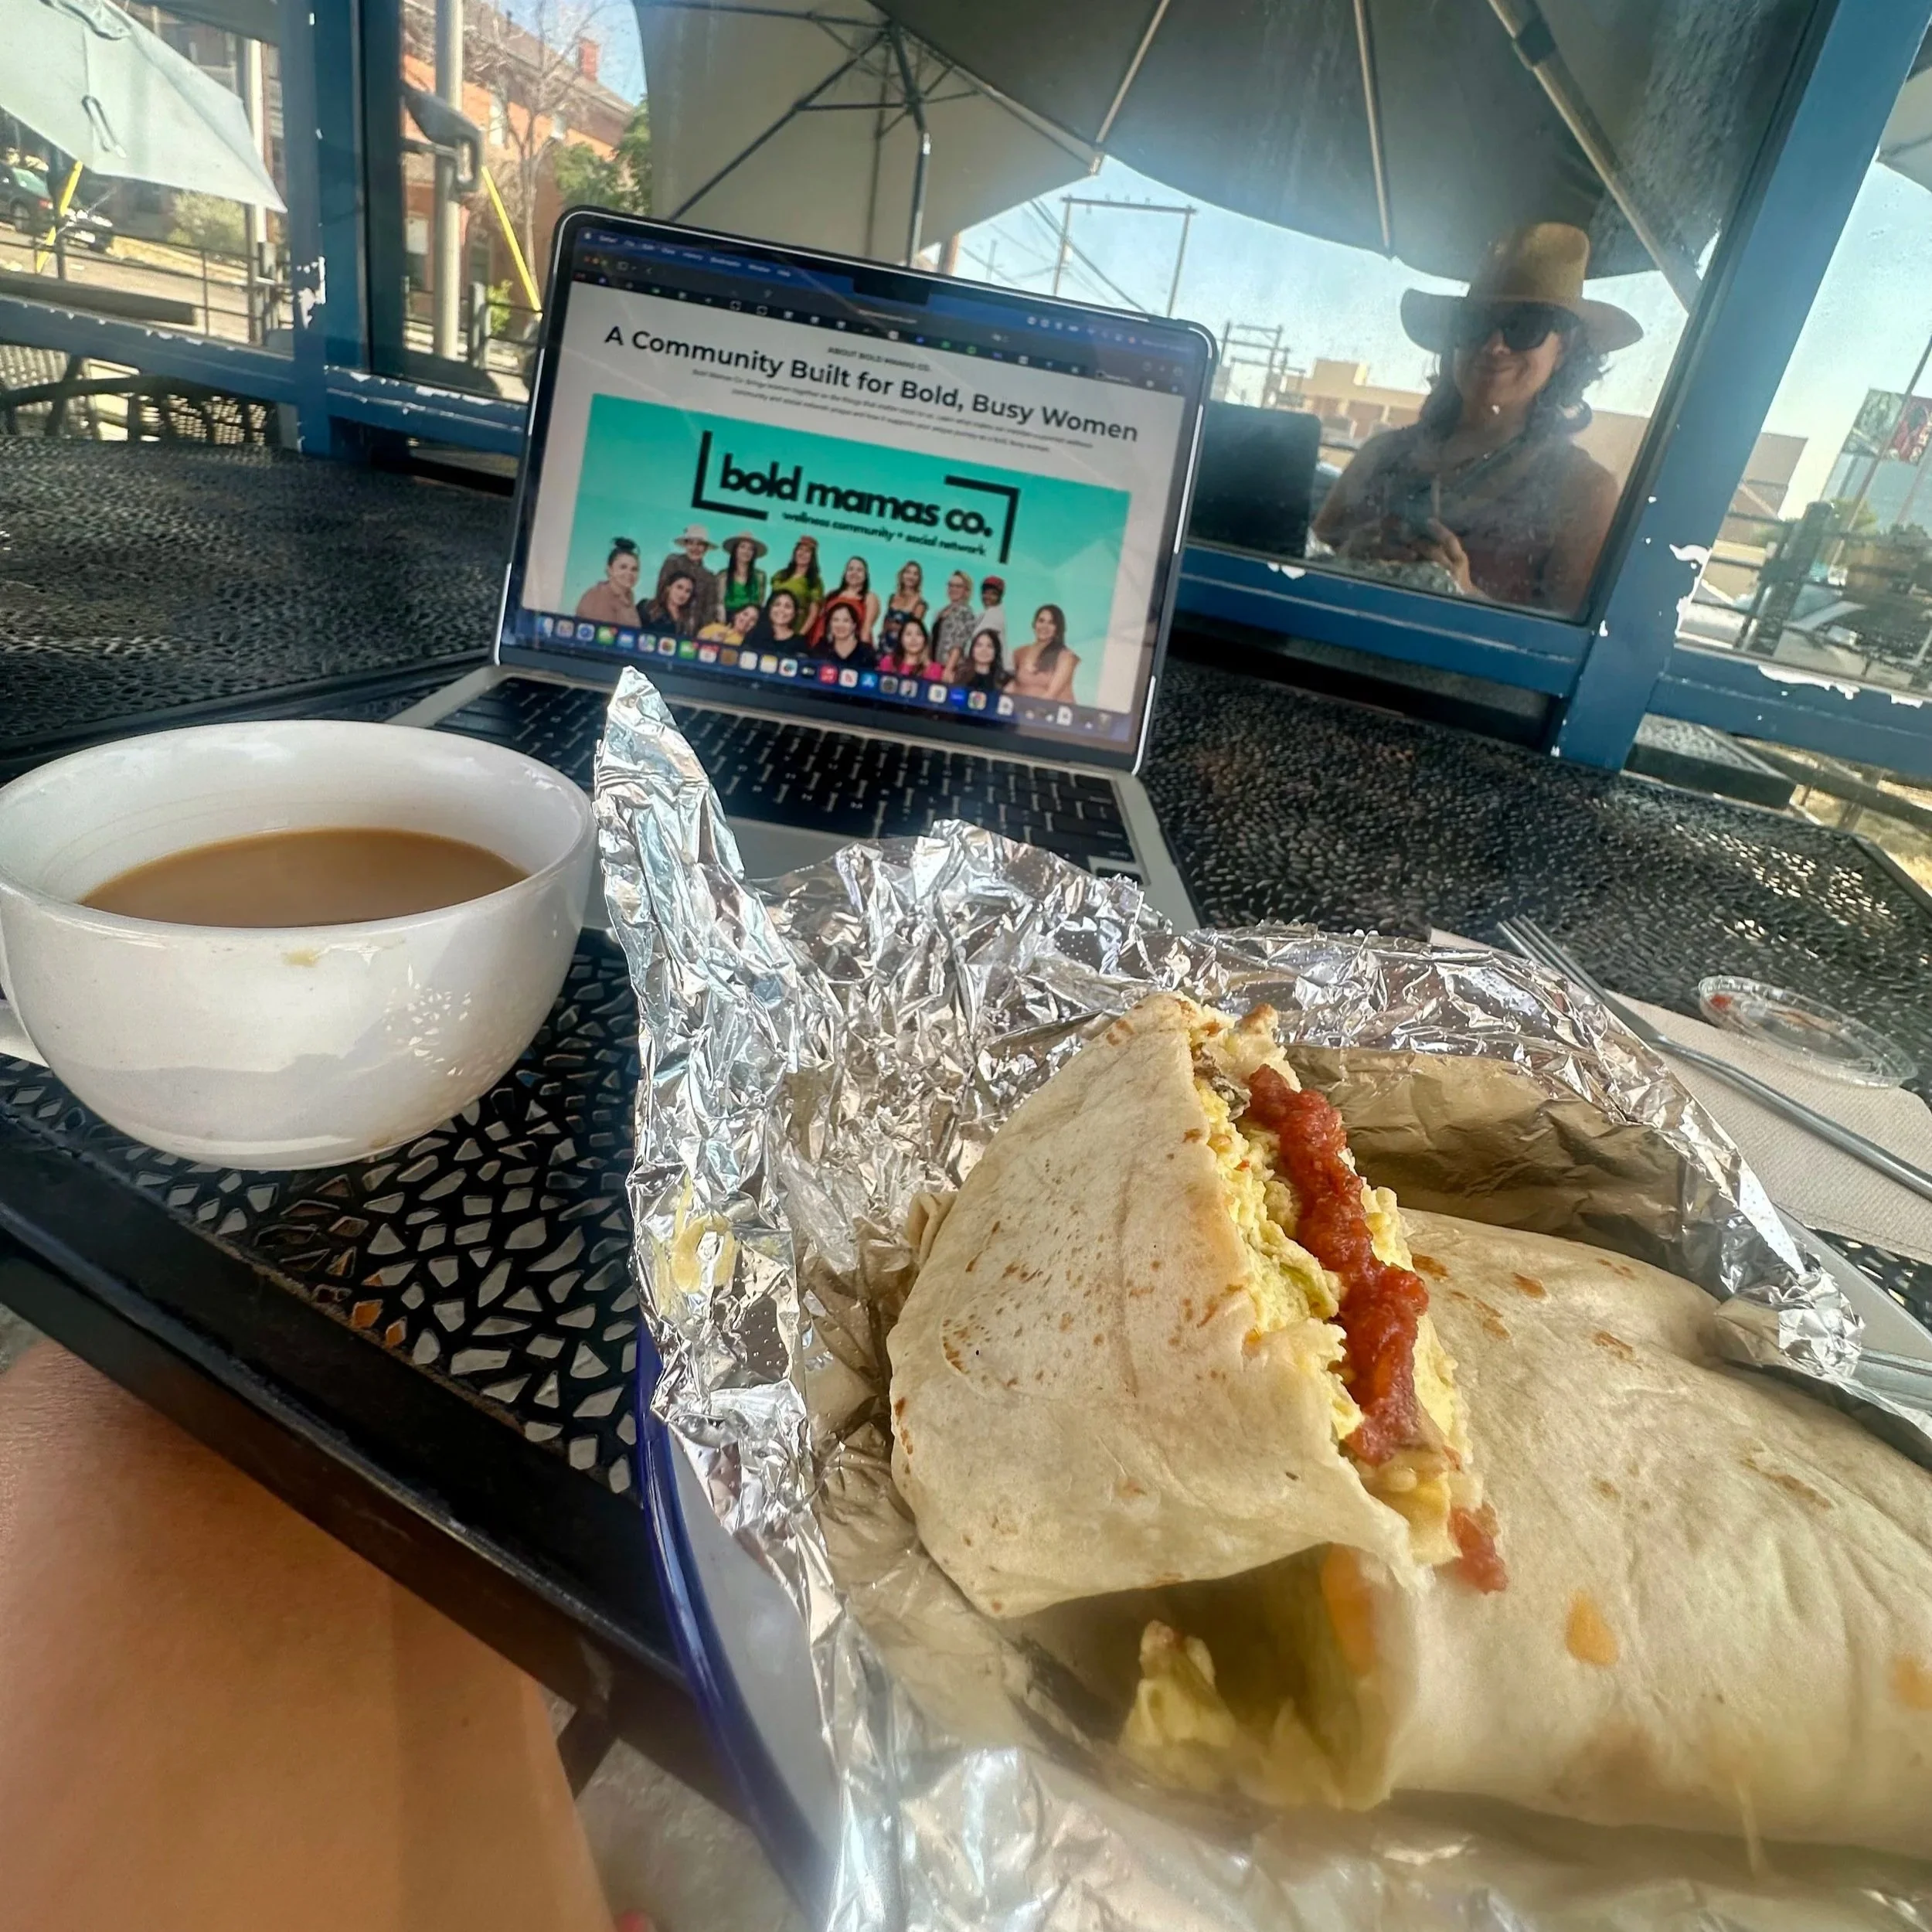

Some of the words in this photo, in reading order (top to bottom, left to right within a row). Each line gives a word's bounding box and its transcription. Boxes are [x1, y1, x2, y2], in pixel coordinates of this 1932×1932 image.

[604, 326, 624, 346] A
[632, 330, 784, 378] Community
[791, 359, 851, 388] Built
[856, 371, 894, 395] for
[900, 379, 964, 412] Bold,
[972, 393, 1035, 424] Busy
[1042, 406, 1138, 441] Women
[719, 452, 803, 502] bold
[805, 481, 940, 528] mamas
[944, 508, 993, 538] co.
[782, 511, 830, 528] wellness
[832, 520, 895, 542] community
[906, 533, 938, 547] social
[939, 540, 986, 556] network
